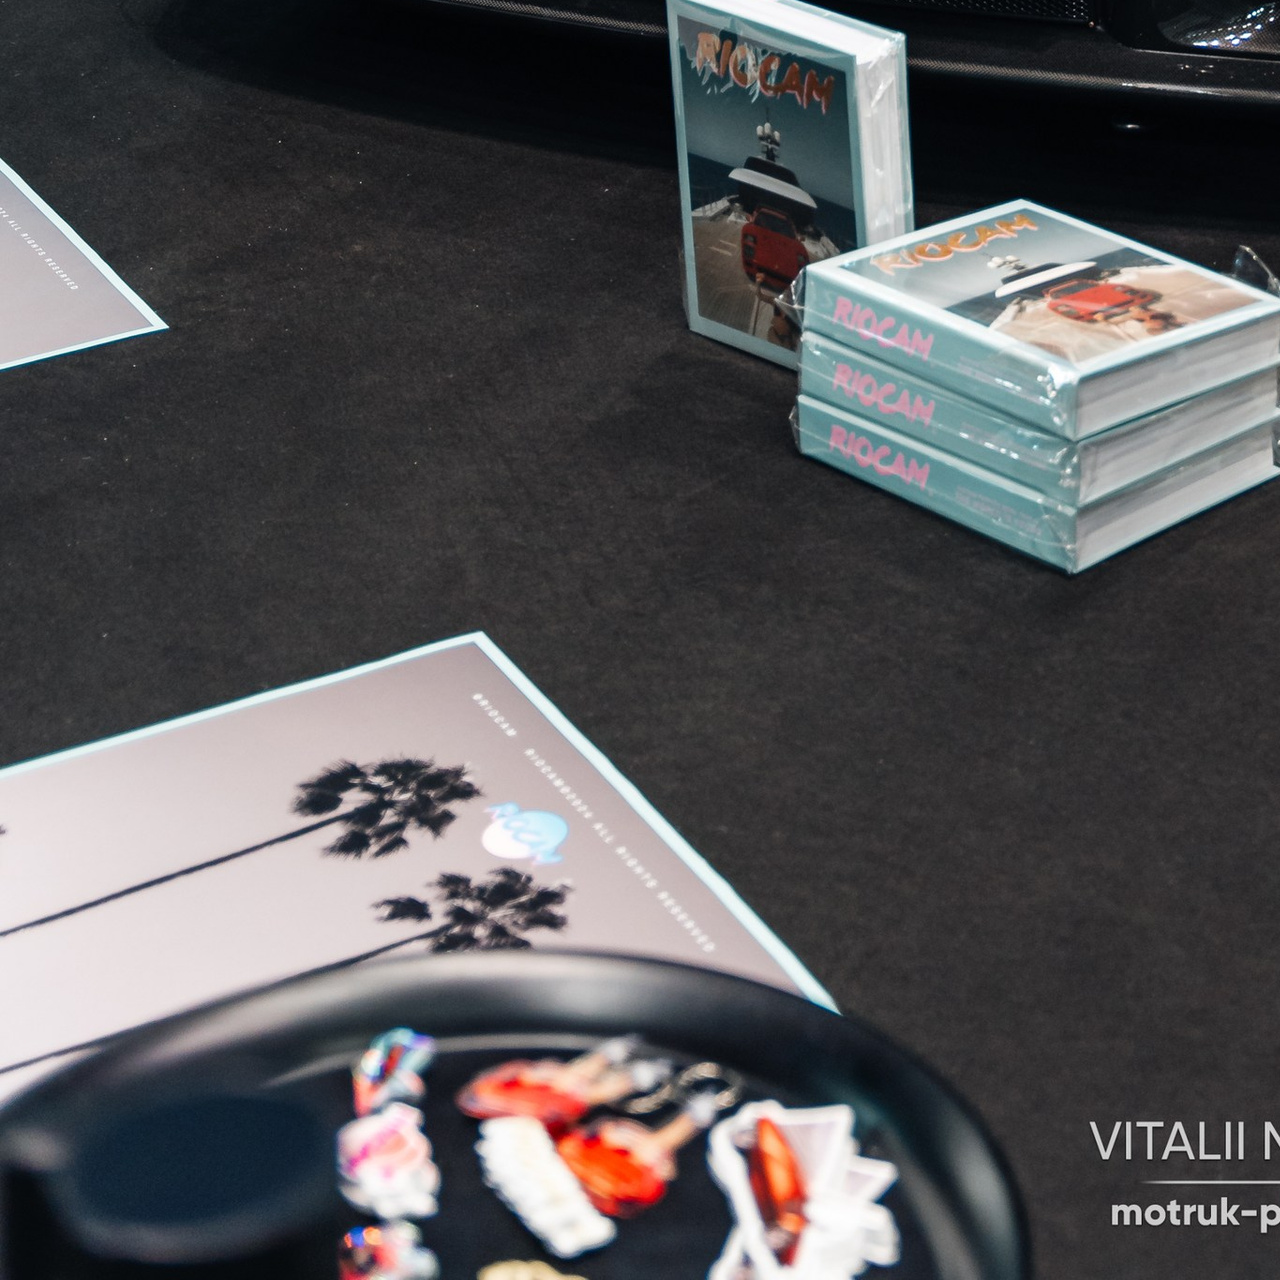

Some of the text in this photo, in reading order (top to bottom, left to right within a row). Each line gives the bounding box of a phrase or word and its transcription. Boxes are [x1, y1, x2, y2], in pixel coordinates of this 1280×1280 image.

[695, 31, 835, 116] RIOCAM
[7, 220, 22, 231] ALL
[20, 233, 46, 256] RIGHTS
[44, 258, 79, 290] RESERVED
[869, 214, 1040, 277] RIOCAM
[832, 296, 935, 363] RIOCAM
[832, 363, 936, 427] RIOCAM
[829, 424, 931, 490] RIOCAM
